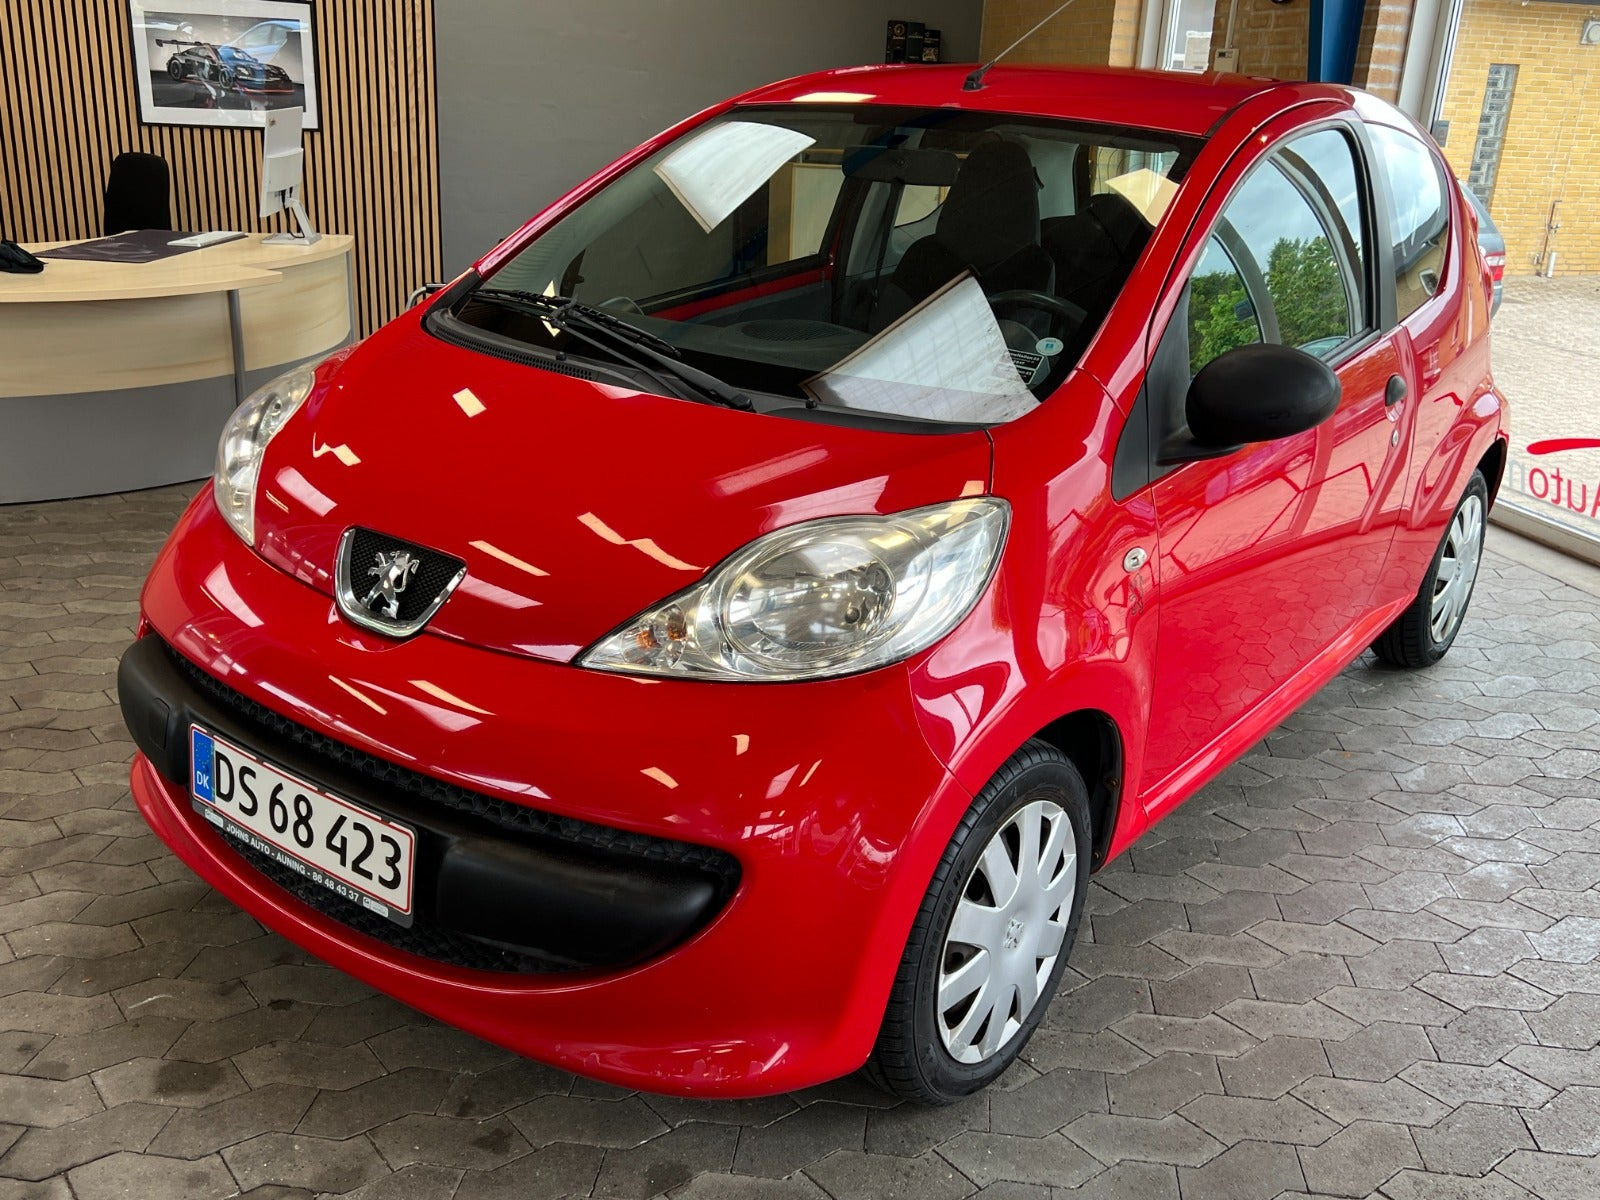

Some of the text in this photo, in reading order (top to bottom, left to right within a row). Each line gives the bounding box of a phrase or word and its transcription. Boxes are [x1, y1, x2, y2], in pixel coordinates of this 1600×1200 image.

[196, 771, 210, 790] DK
[215, 750, 402, 890] DS 68 423
[226, 823, 250, 843] JOHNS
[251, 837, 270, 855] AUTO
[276, 852, 306, 875] AUNING
[324, 878, 335, 890] 48
[336, 884, 347, 896] 43
[348, 890, 360, 902] 37
